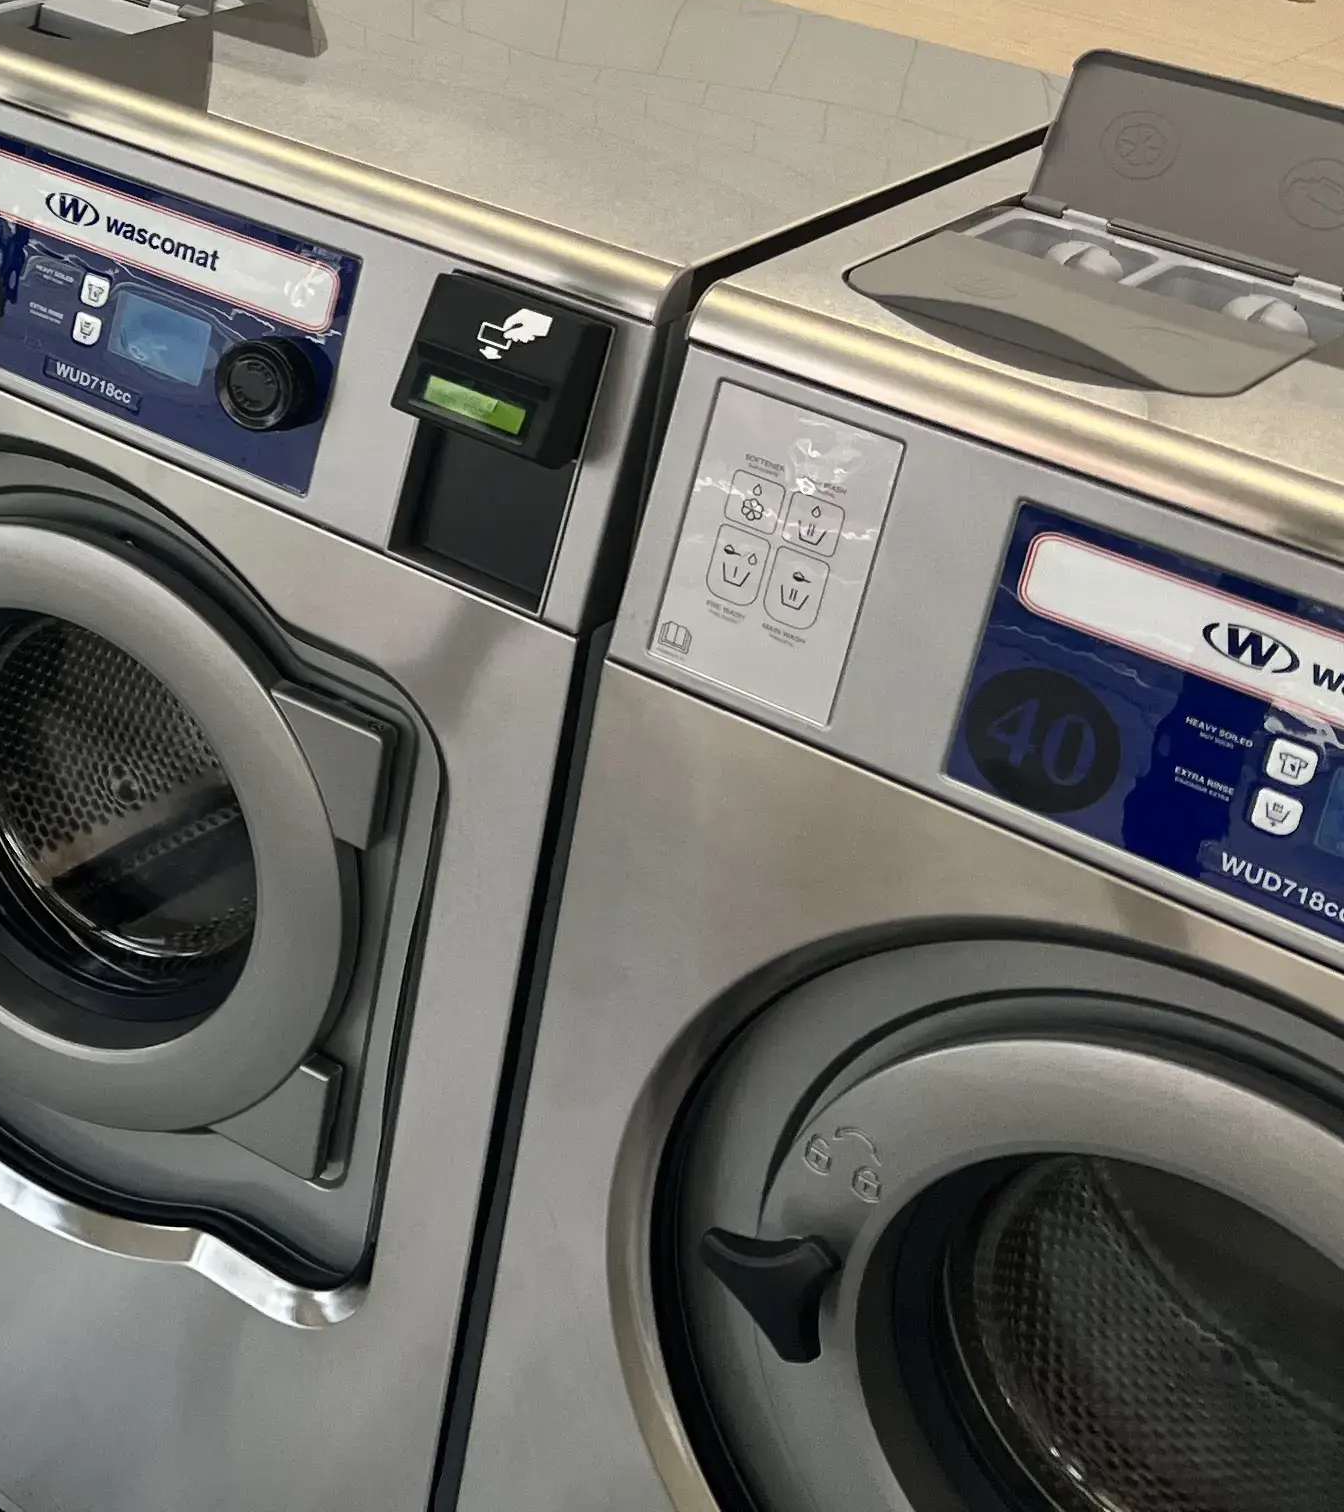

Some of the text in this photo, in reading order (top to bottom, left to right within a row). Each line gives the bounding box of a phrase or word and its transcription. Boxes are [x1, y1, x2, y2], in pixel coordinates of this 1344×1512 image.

[105, 215, 220, 271] wascomat
[55, 361, 132, 405] WUD718cc
[986, 698, 1097, 786] 40
[1185, 716, 1254, 748] HEAVY SOILED
[1174, 765, 1235, 796] EXTRA RINSE
